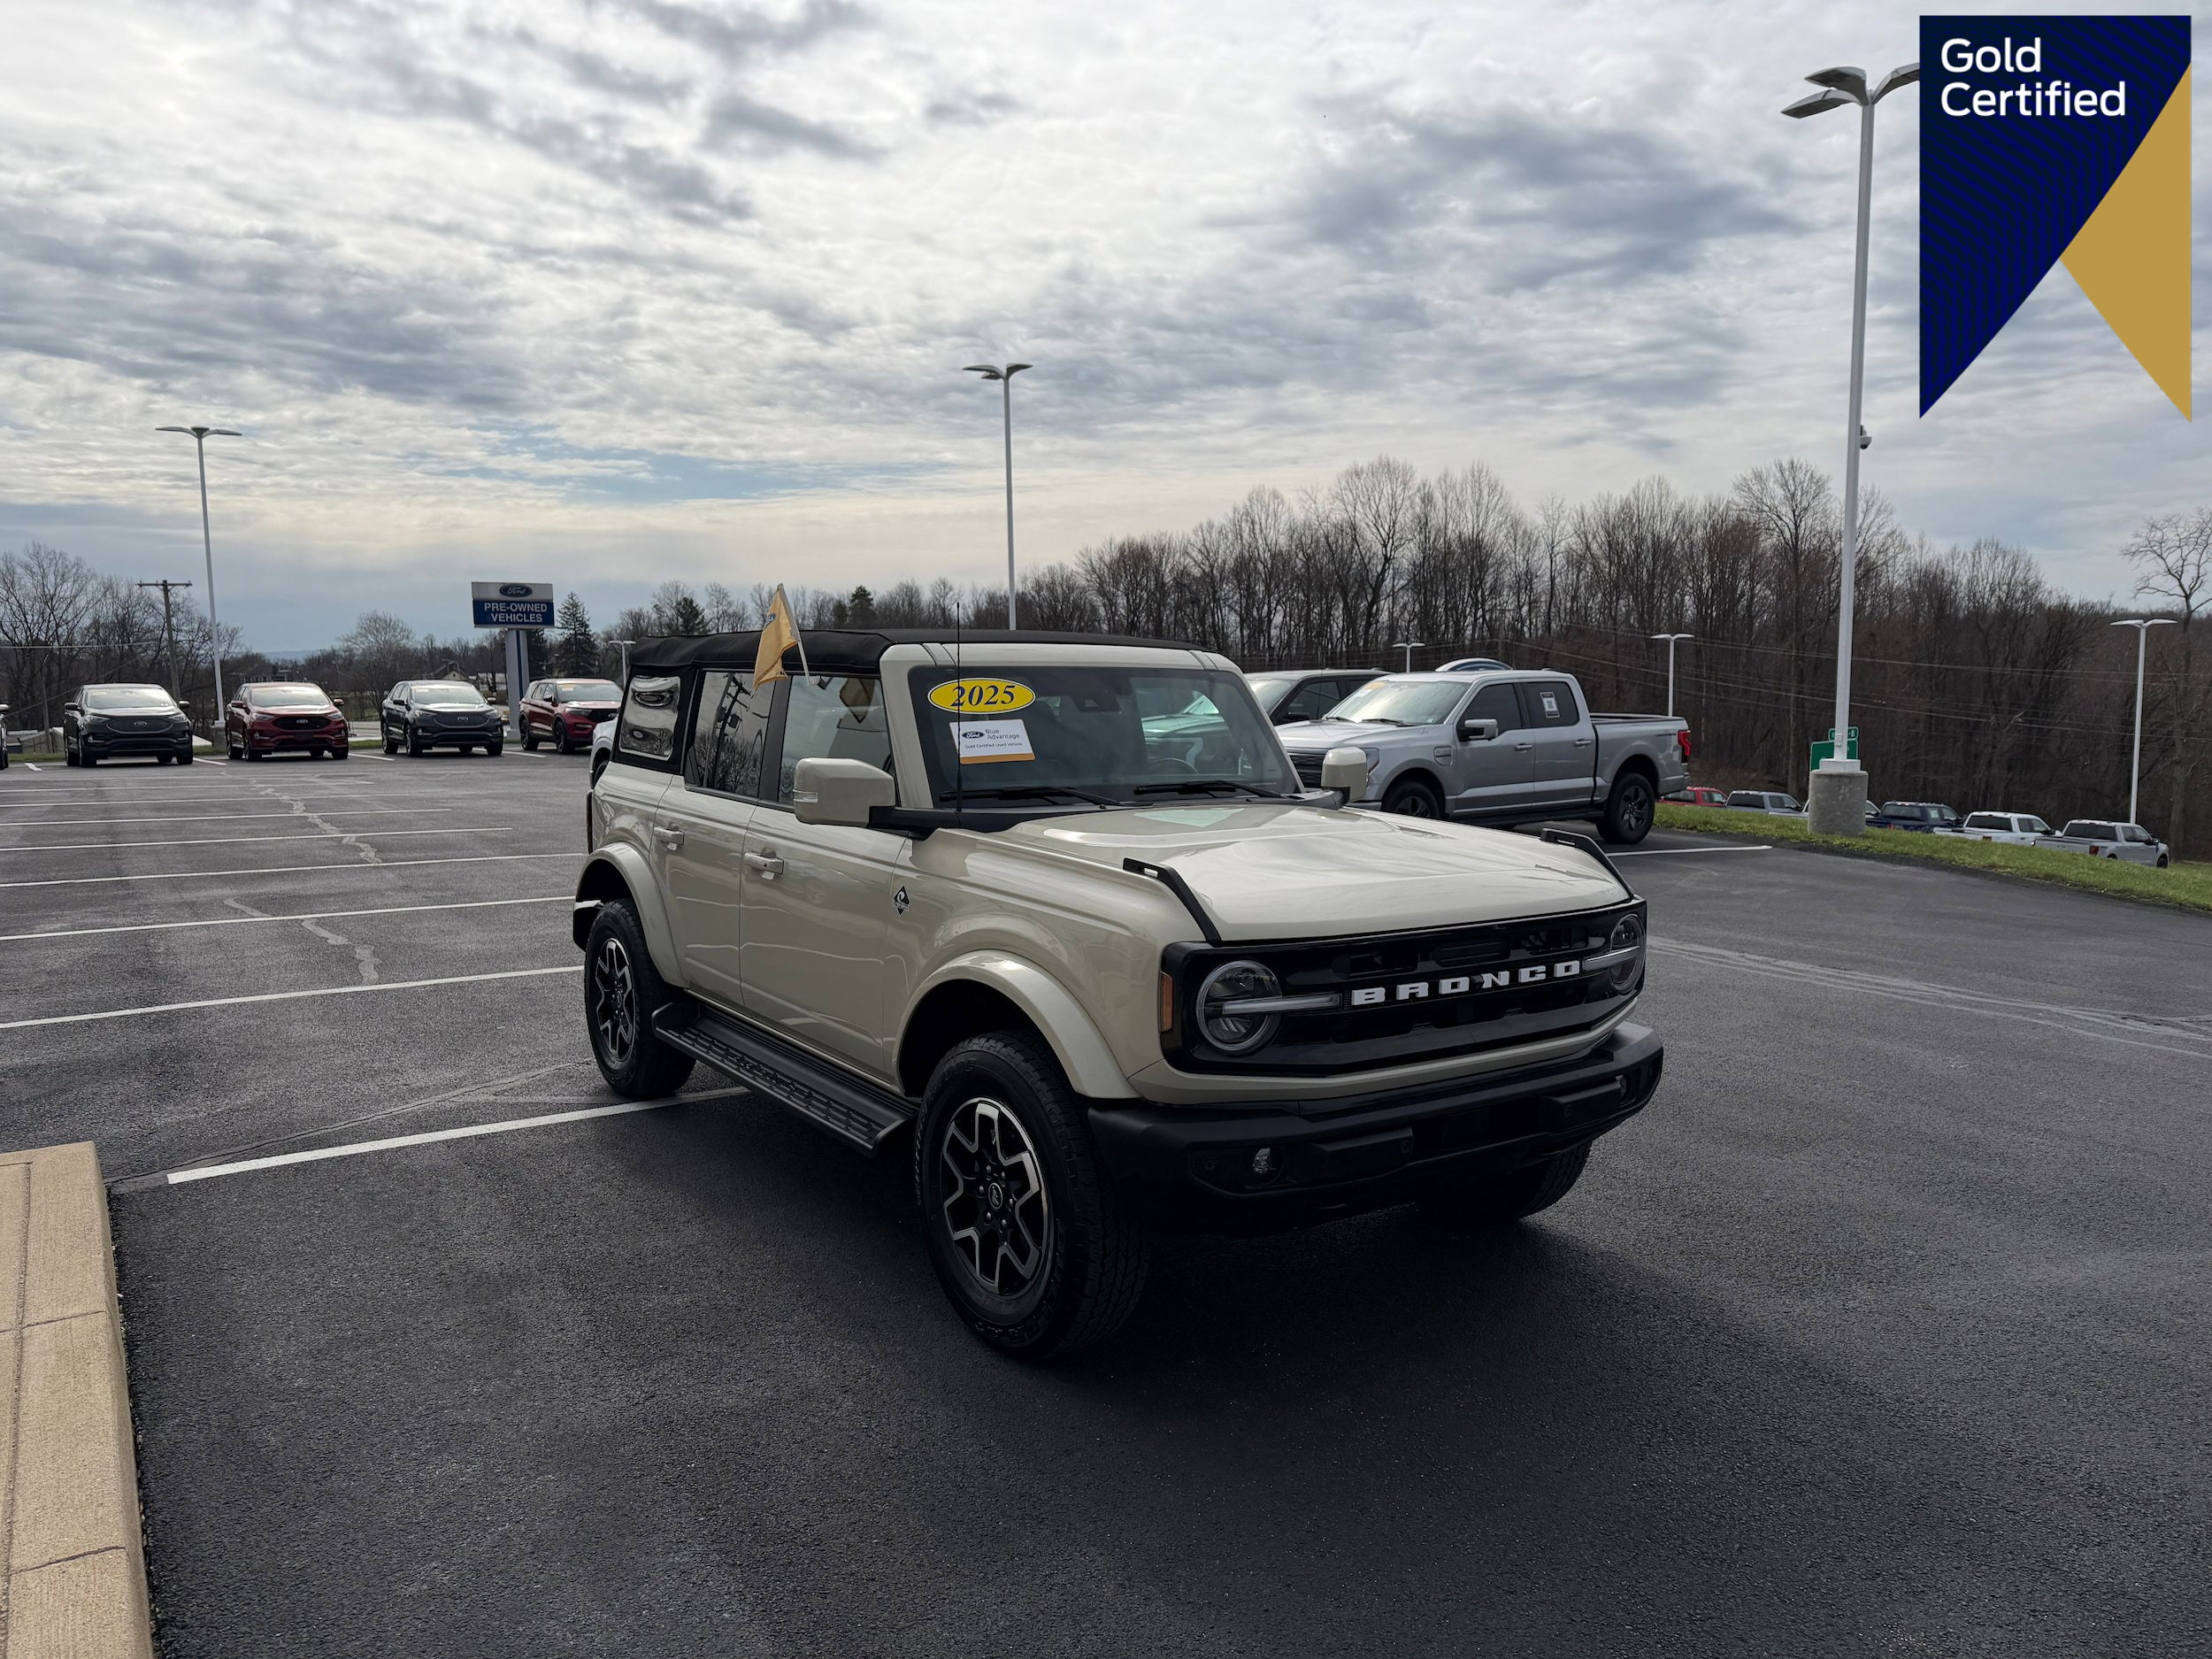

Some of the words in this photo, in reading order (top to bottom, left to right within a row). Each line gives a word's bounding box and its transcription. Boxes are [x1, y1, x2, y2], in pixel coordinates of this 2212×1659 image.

[484, 603, 548, 612] PRE-OWNED
[491, 613, 542, 623] VEHICLES
[949, 685, 1016, 707] 2025
[1351, 960, 1580, 1006] BRONCO
